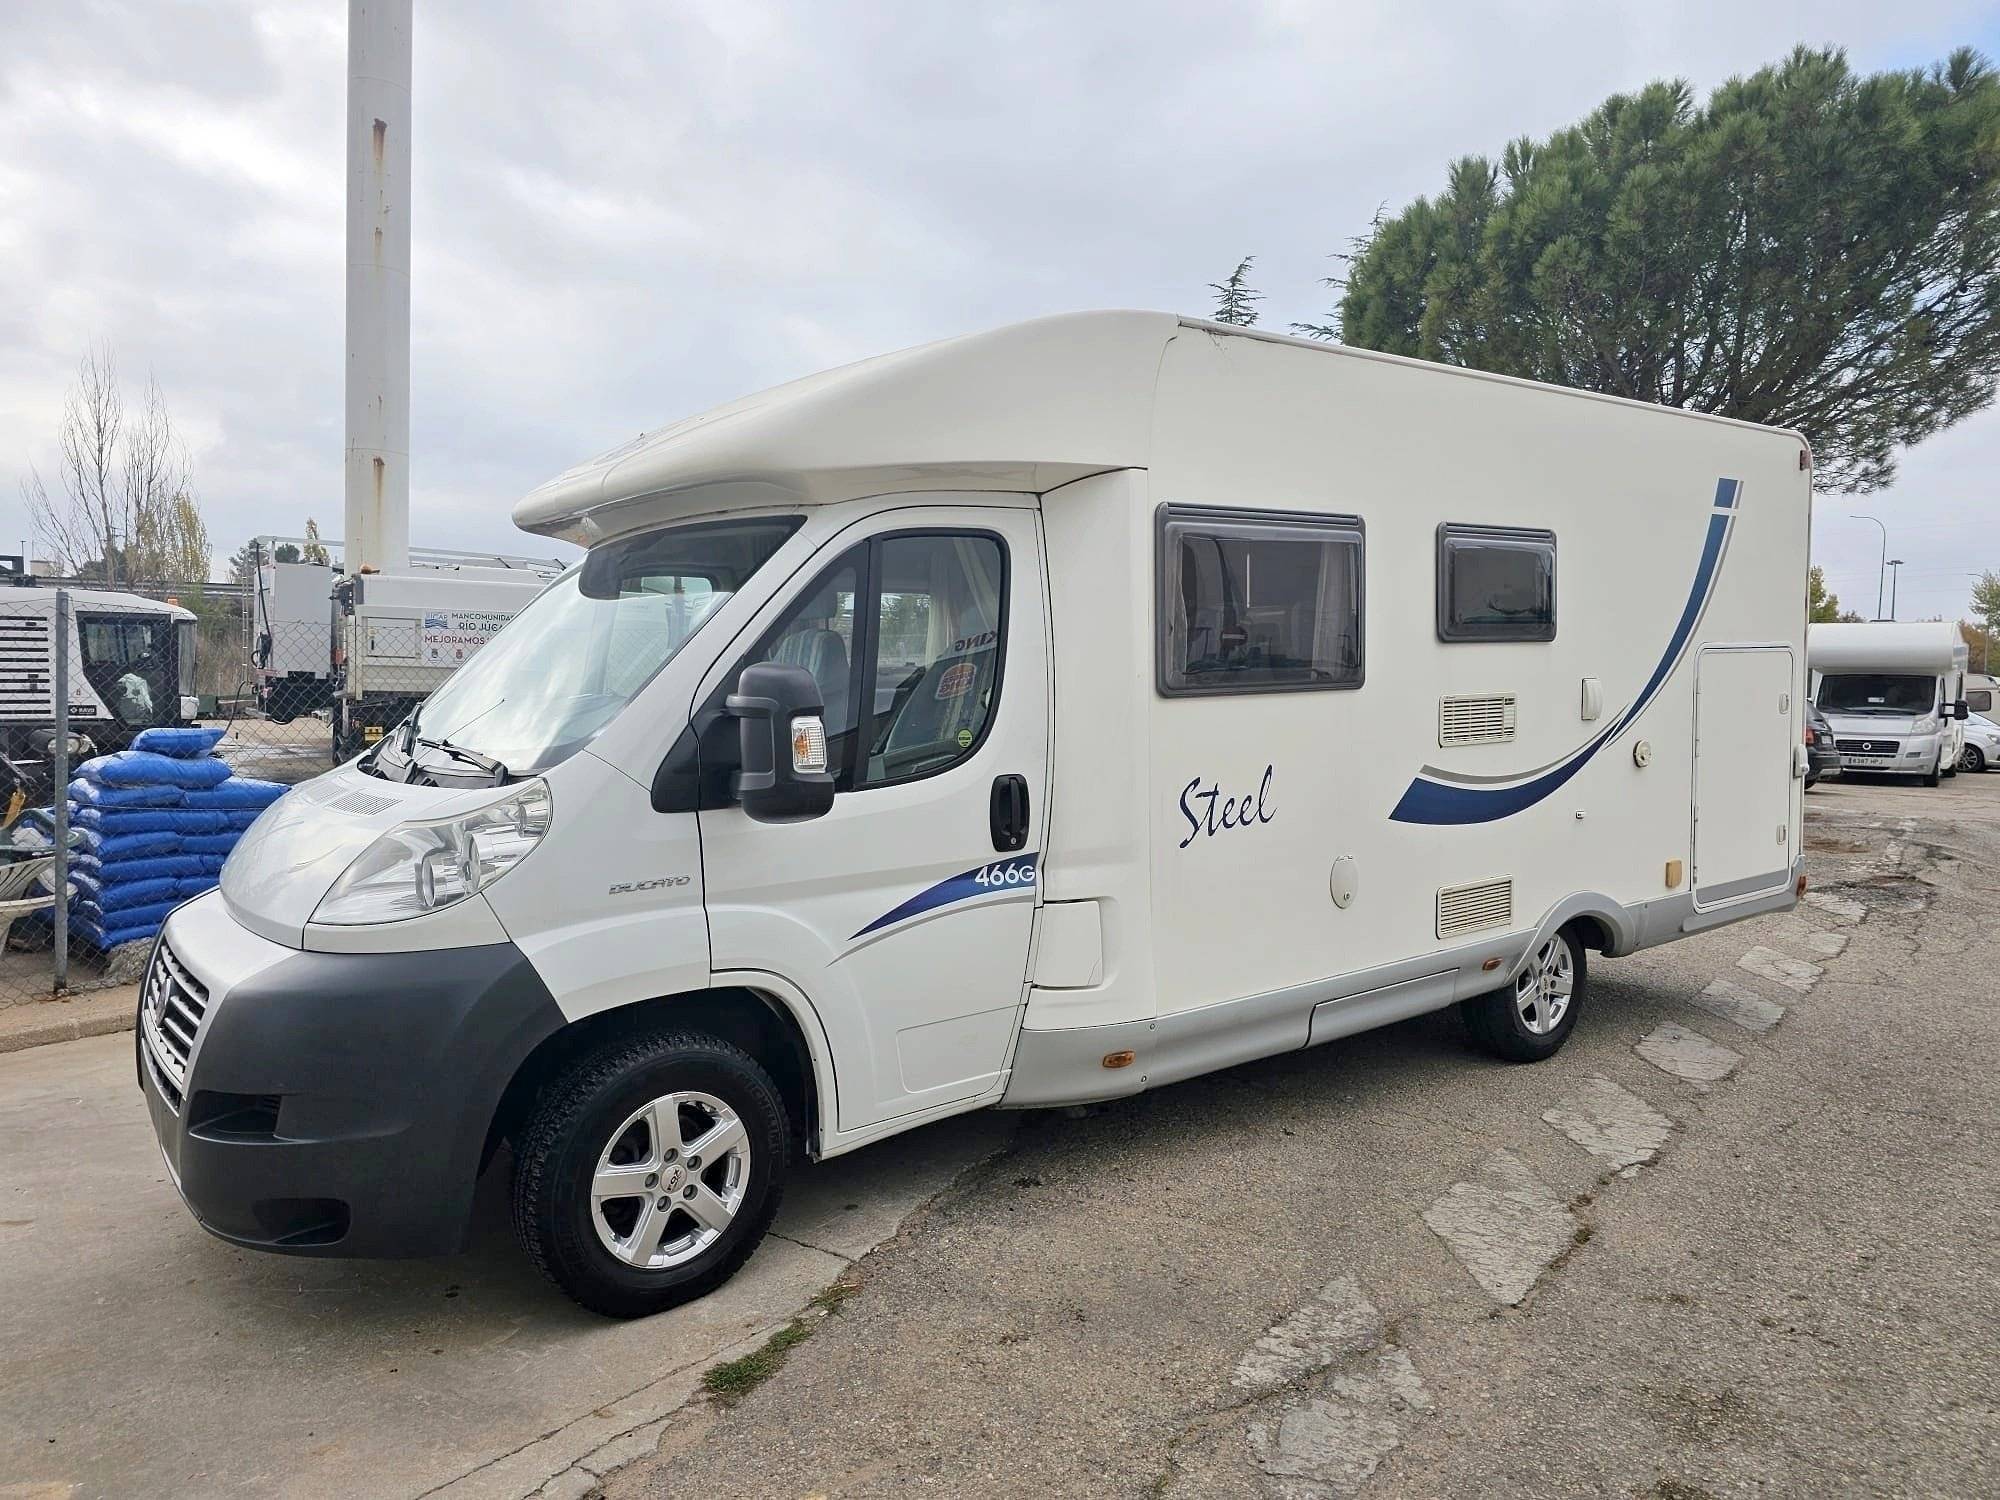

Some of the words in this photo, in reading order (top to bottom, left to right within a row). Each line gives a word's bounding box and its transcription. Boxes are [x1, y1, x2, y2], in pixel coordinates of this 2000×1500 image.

[459, 620, 477, 631] RÍO
[425, 635, 485, 645] MEJORAMOS
[1180, 764, 1277, 848] Steel
[975, 863, 1035, 886] 466G
[608, 875, 691, 895] DUCATO
